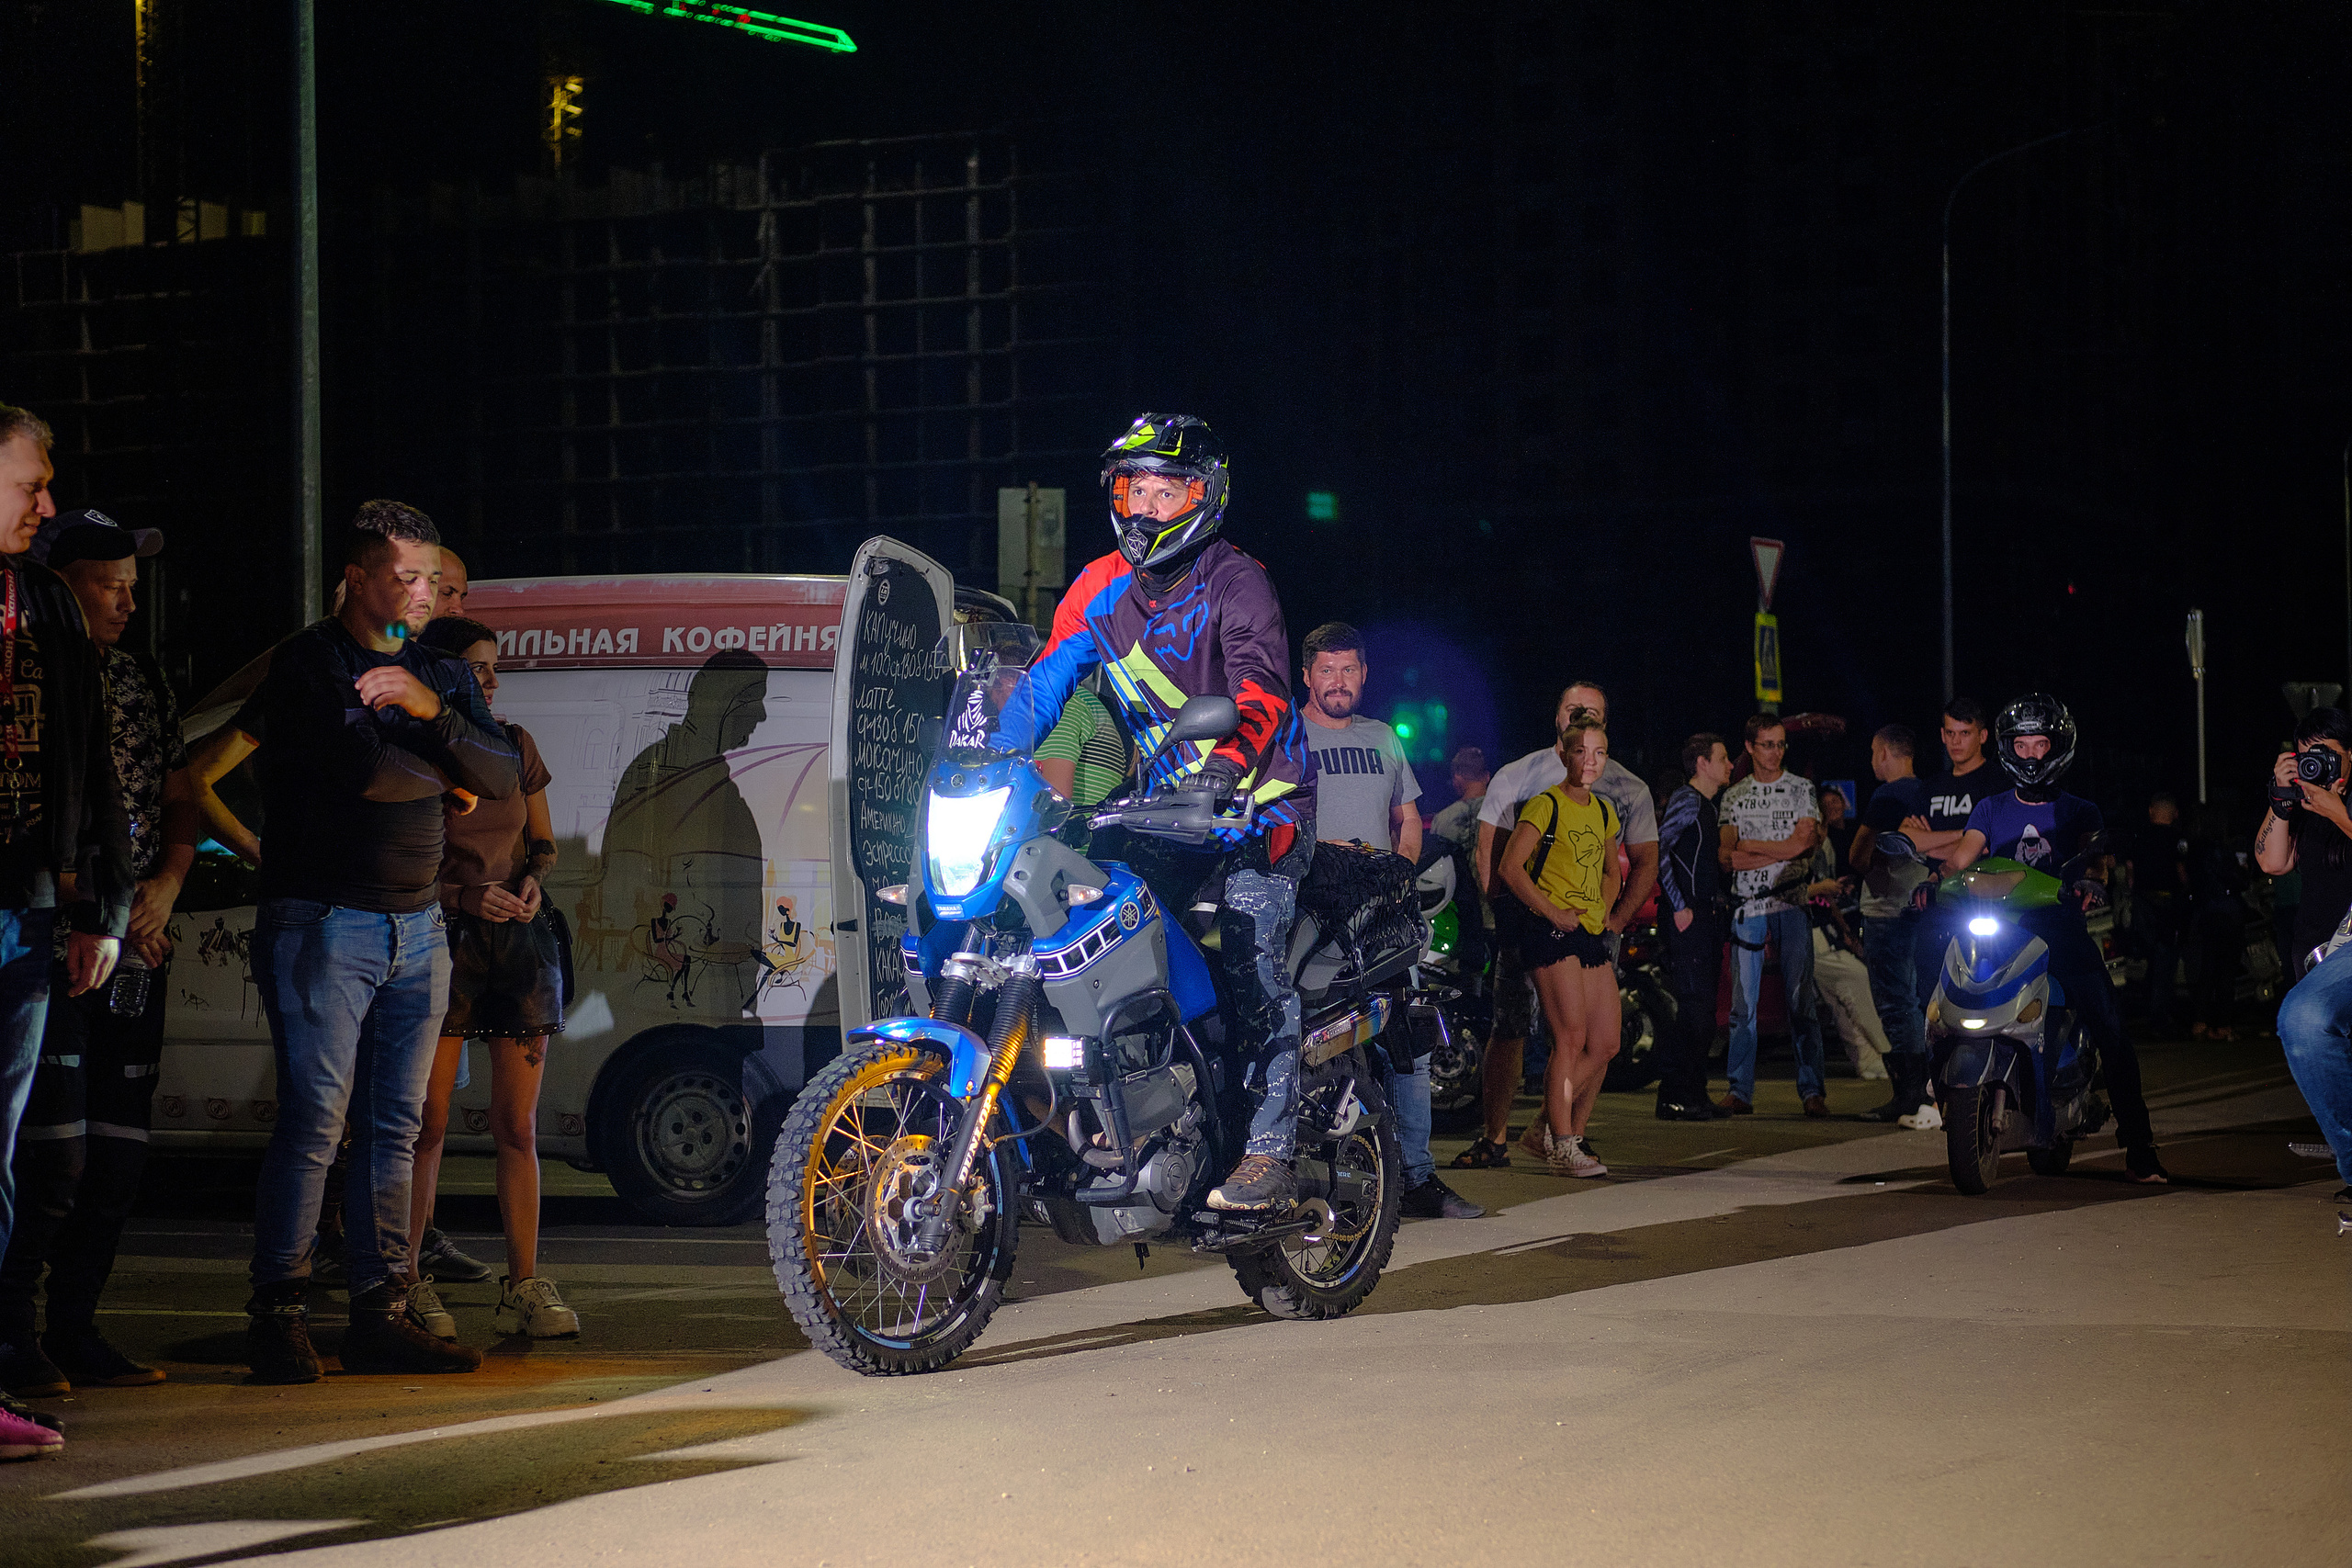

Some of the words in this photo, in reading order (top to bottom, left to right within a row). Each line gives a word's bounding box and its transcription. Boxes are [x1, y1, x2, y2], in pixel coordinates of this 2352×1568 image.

[7, 575, 17, 618] HONDA
[662, 623, 840, 653] КОФЕЙНЯ
[948, 729, 986, 749] DAKAR
[1929, 793, 1973, 818] FILA
[1754, 870, 1768, 882] 78
[958, 1093, 992, 1186] DUNLOP
